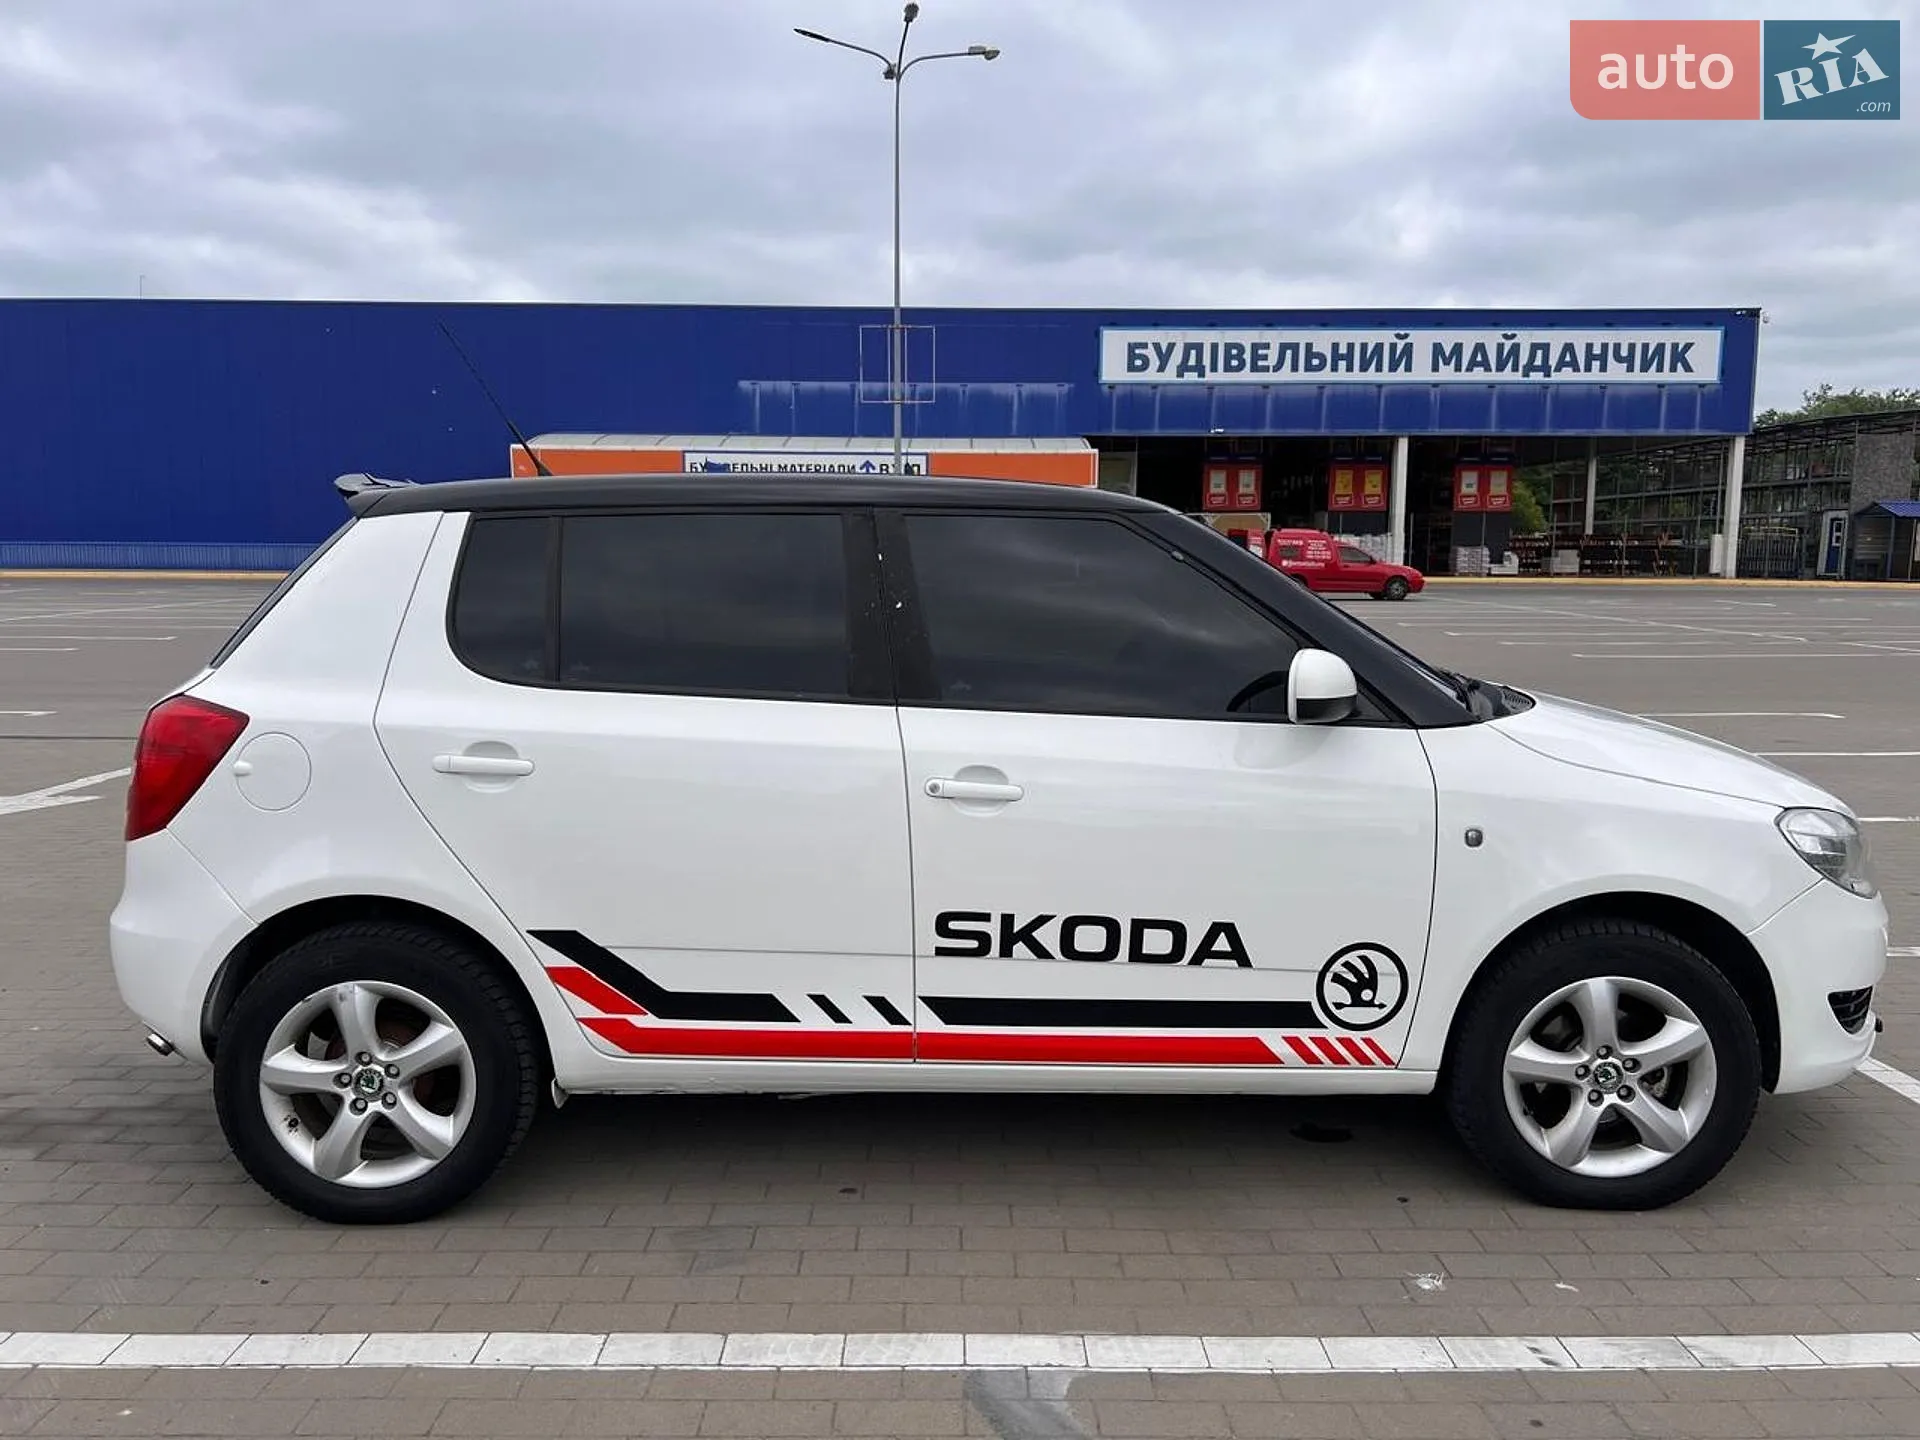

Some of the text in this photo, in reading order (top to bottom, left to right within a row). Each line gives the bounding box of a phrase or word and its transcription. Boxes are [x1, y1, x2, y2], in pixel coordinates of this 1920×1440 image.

[1126, 332, 1695, 379] БУДІВЕЛЬНИЙ МАЙДАНЧИК
[689, 461, 773, 473] БУЕЛЬНІ
[879, 463, 921, 476] ВД
[934, 910, 1254, 968] SKODA
